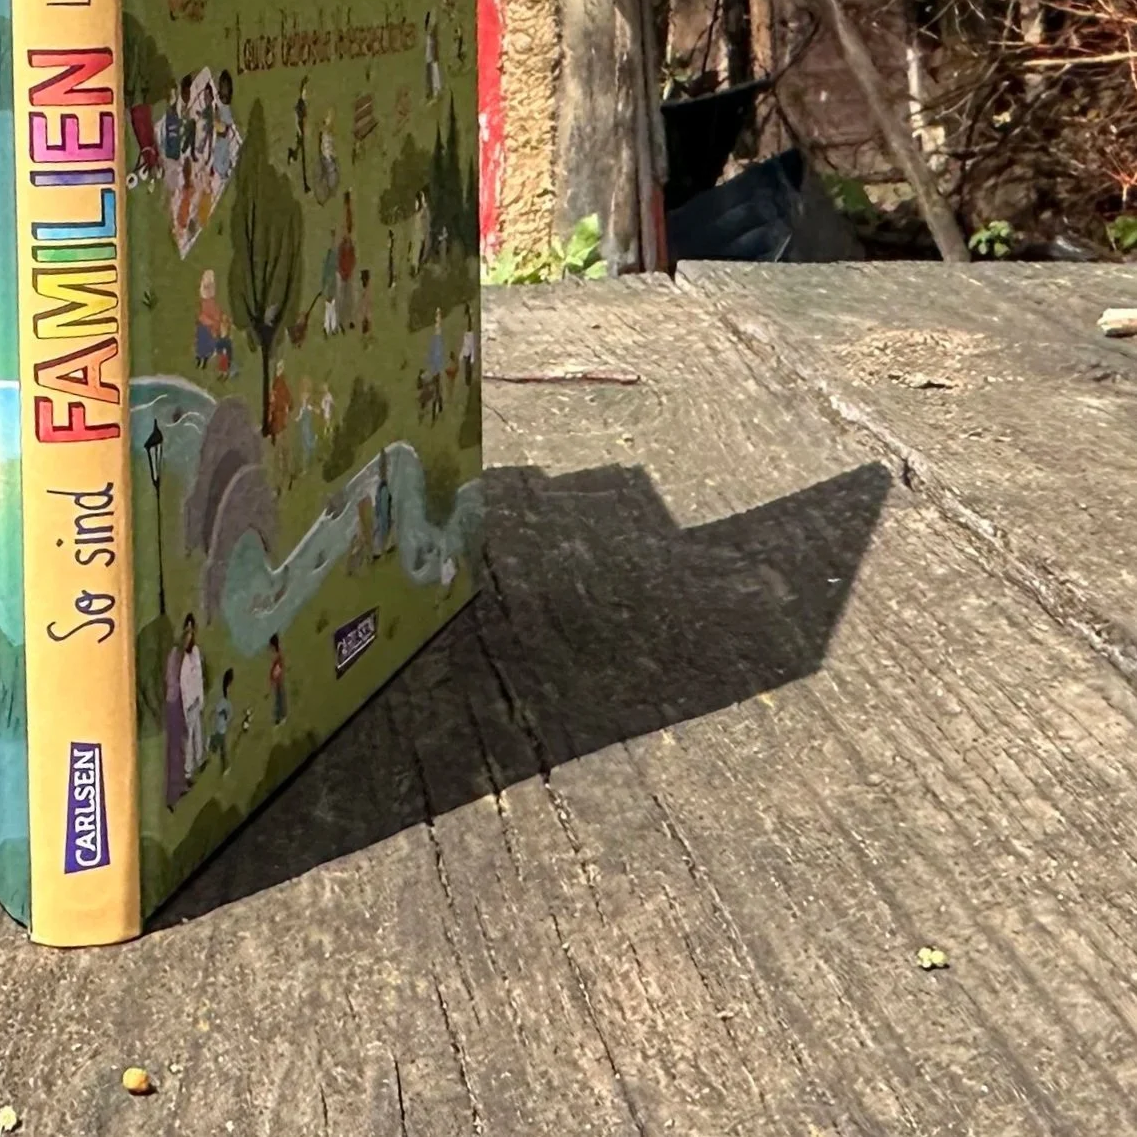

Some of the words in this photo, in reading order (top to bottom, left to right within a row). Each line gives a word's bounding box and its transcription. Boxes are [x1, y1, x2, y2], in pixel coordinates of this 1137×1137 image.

[27, 46, 121, 444] FAMILIEN
[45, 481, 117, 568] sind
[45, 589, 117, 644] So
[72, 746, 103, 868] CARLSEN
